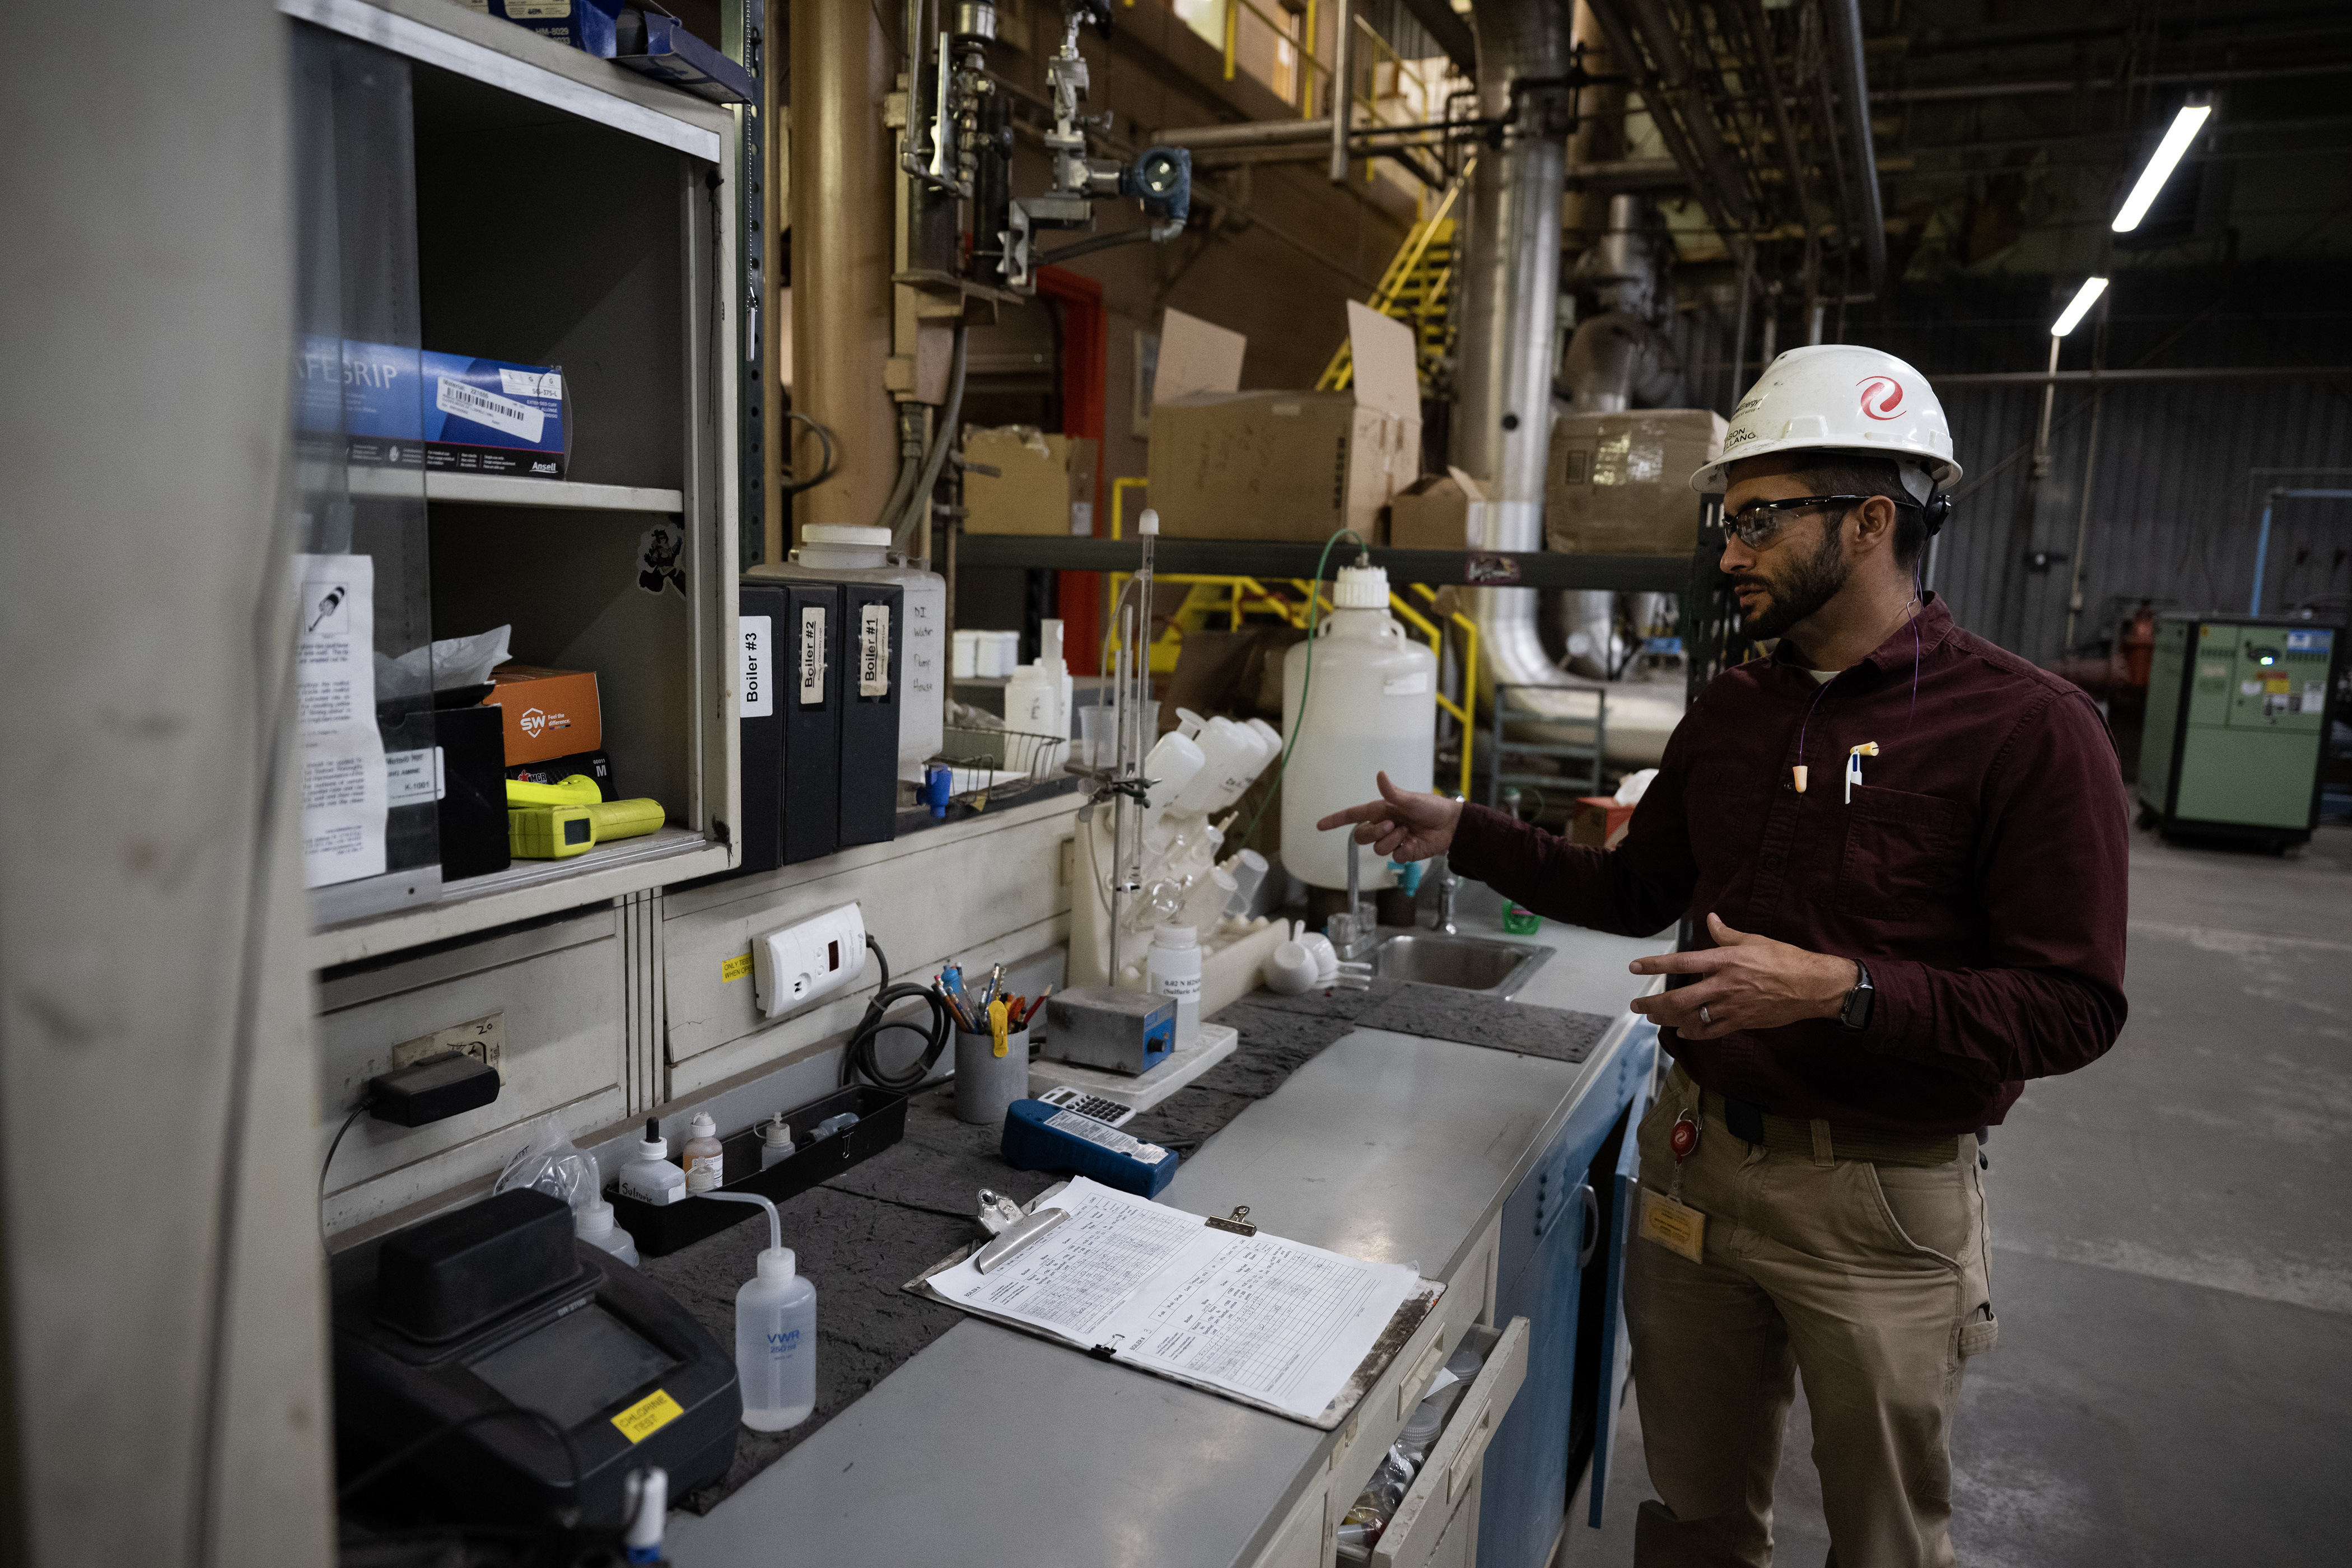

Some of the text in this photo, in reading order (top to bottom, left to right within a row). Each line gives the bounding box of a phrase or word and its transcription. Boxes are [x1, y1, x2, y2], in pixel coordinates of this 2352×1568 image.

[531, 461, 557, 472] Ansell
[805, 621, 814, 688] Boiler #2
[865, 619, 876, 681] Boiler #1
[745, 632, 758, 702] Boiler #3
[520, 715, 545, 731] SW
[531, 772, 547, 782] MCR
[596, 764, 607, 777] M
[724, 955, 753, 971] ONLY TEST
[724, 964, 754, 979] WHEN OPE
[964, 1288, 979, 1298] BOILER
[1183, 1314, 1193, 1323] Boiler
[767, 1329, 800, 1344] VWR
[1129, 1339, 1144, 1351] BOILER
[618, 1395, 665, 1428] CHLORINE
[633, 1413, 658, 1432] TEST
